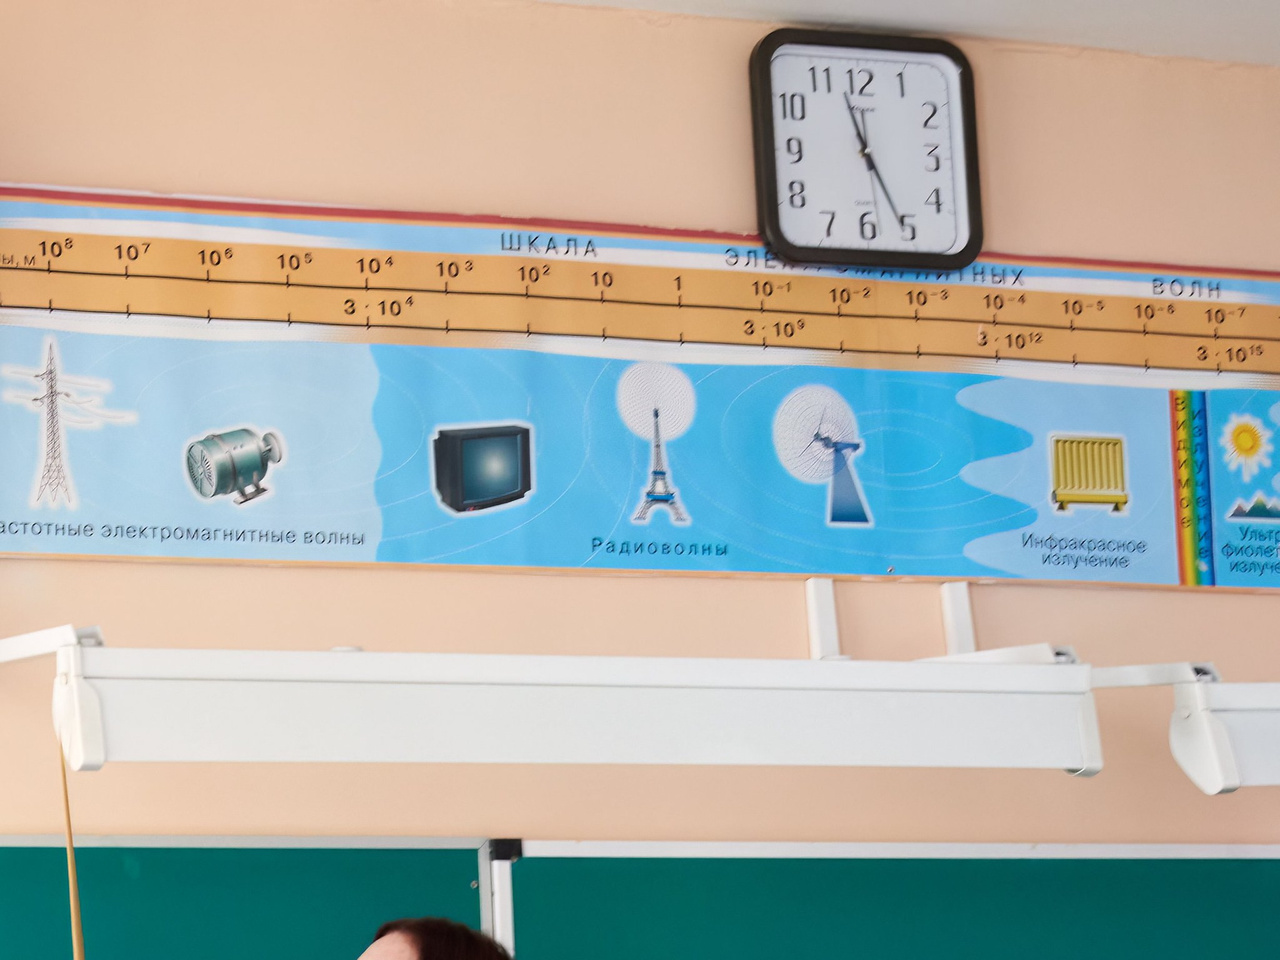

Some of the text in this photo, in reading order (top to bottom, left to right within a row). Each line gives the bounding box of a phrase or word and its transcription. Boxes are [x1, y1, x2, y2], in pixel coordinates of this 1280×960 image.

[808, 66, 831, 93] 11
[846, 68, 875, 97] 12
[896, 71, 905, 98] 1
[778, 92, 806, 121] 10
[921, 101, 939, 129] 2
[787, 136, 803, 164] 9
[923, 143, 941, 172] 3
[788, 180, 806, 209] 8
[924, 187, 942, 214] 4
[819, 211, 836, 238] 7
[859, 211, 877, 240] 6
[899, 214, 916, 242] 5
[24, 255, 36, 266] м
[501, 232, 597, 258] ШКАЛА
[1152, 278, 1220, 299] ВОЛН
[591, 271, 613, 287] 10
[674, 275, 681, 291] 1
[100, 523, 297, 545] электромагнитные
[303, 530, 366, 546] волны
[591, 537, 728, 556] Радиоволны
[1021, 532, 1148, 554] Инфракрасное
[1041, 552, 1130, 569] излучение
